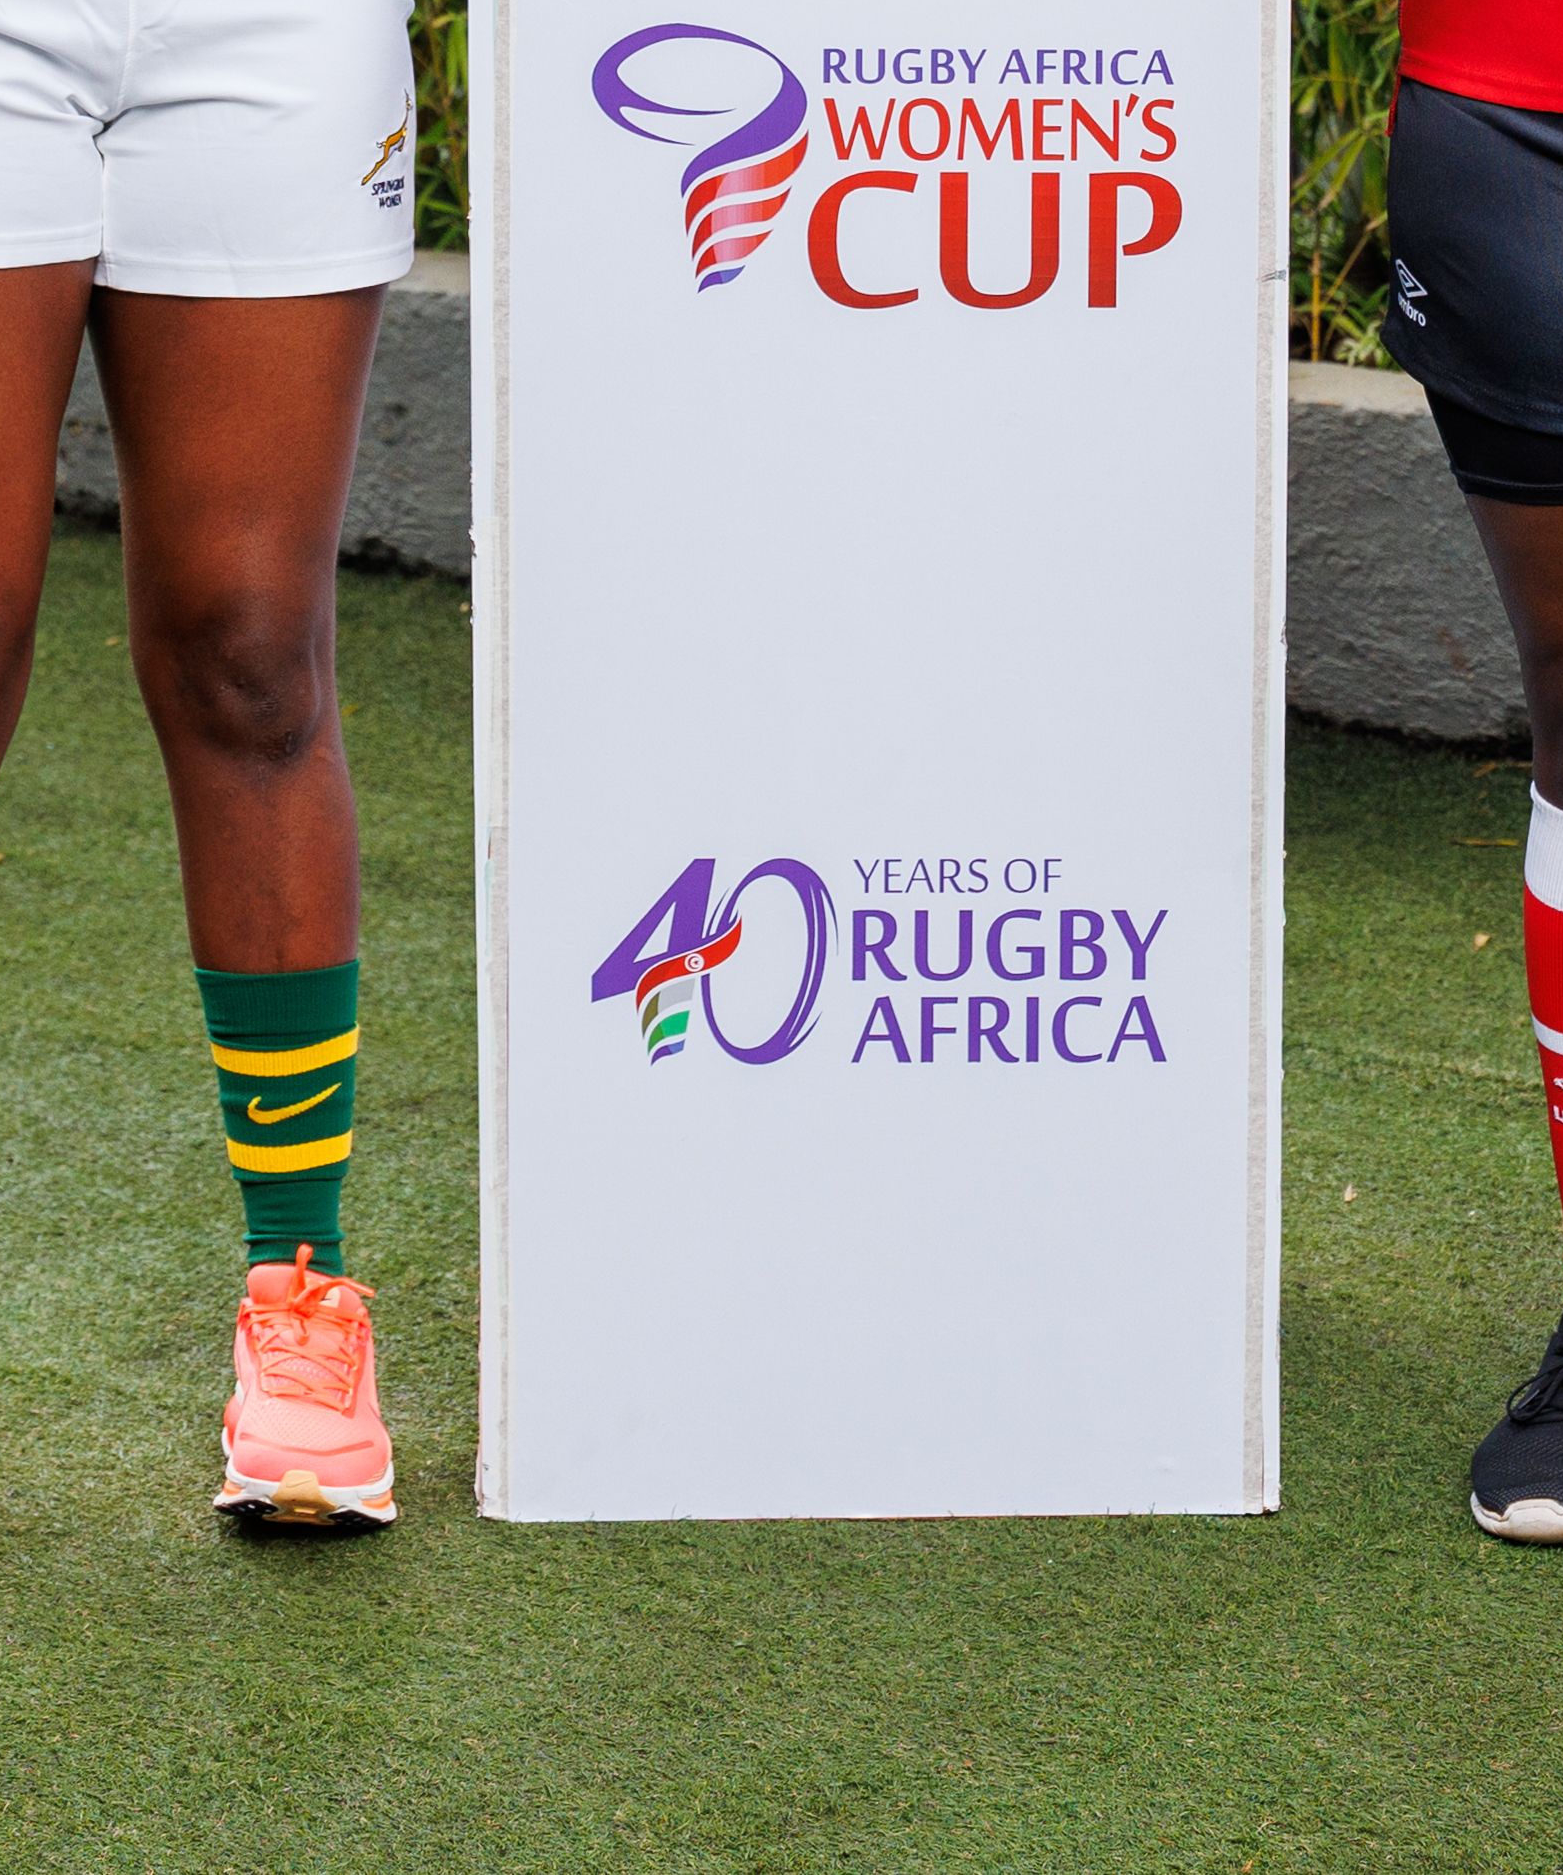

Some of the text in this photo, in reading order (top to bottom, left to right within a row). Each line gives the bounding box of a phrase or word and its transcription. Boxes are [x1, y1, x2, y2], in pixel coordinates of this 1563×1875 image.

[822, 48, 1175, 85] RUGBY AFRICA
[823, 92, 1177, 162] WOMEN'S
[807, 169, 1183, 309] CUP
[853, 858, 1063, 893] YEARS OF
[591, 858, 839, 1065] 40
[851, 909, 1169, 982] RUGBY
[851, 995, 1168, 1063] AFRICA
